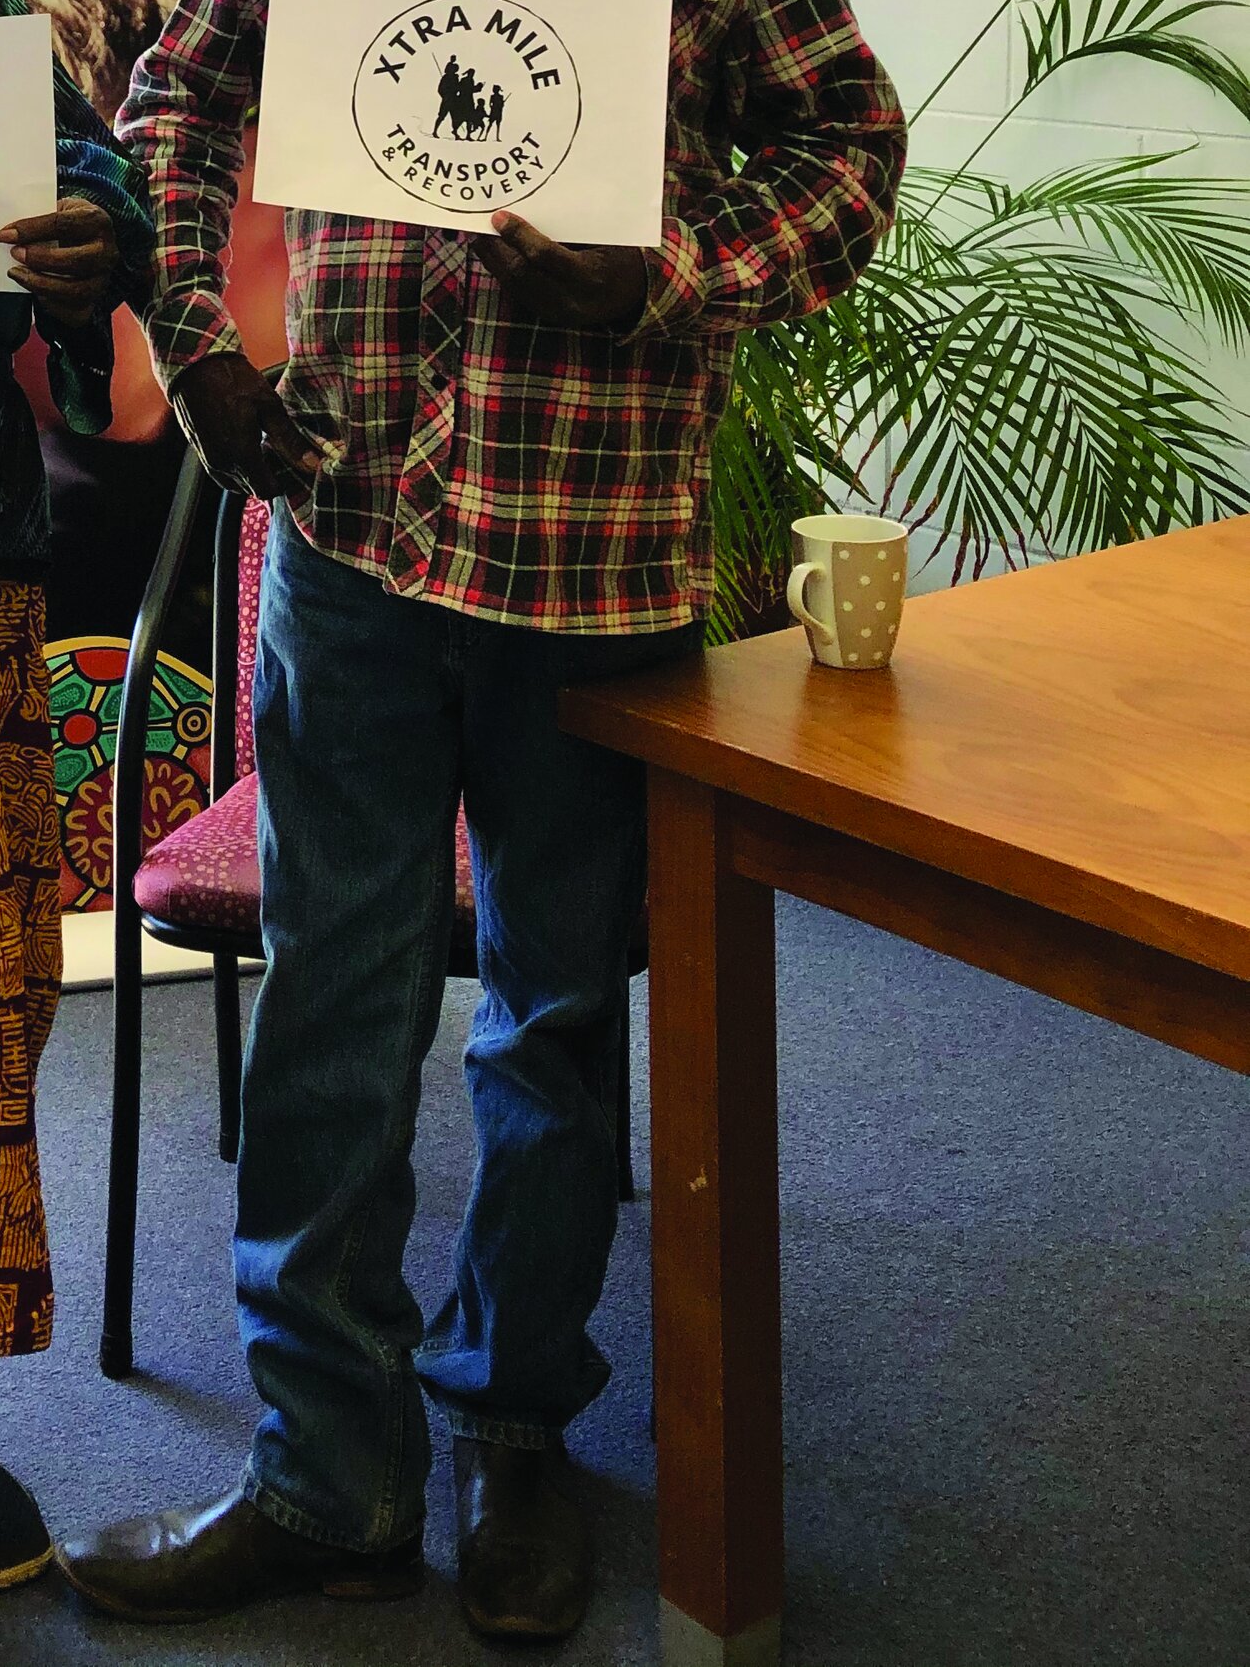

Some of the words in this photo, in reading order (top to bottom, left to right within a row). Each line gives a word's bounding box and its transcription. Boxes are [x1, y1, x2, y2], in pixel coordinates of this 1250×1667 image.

[372, 5, 472, 84] XTRA
[484, 8, 561, 90] MILE
[382, 146, 396, 162] &
[403, 155, 544, 201] RECOVERY
[386, 123, 540, 182] TRANSPORT
